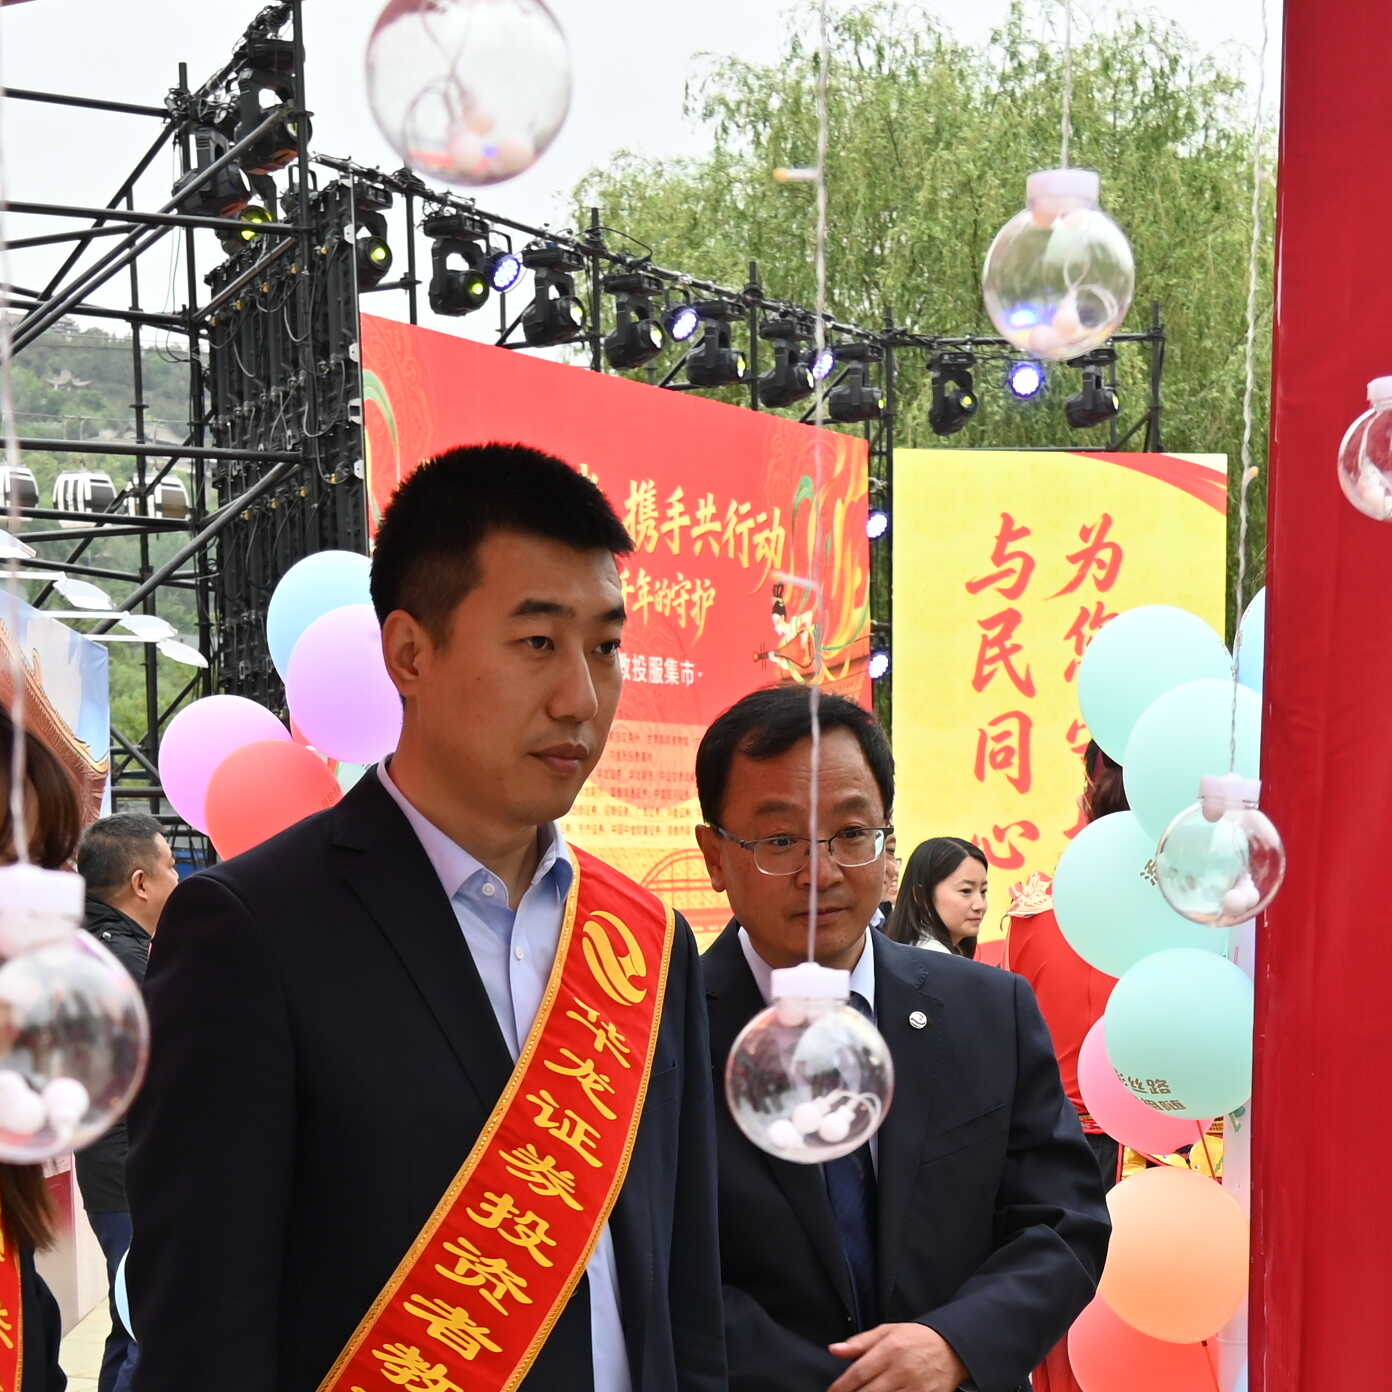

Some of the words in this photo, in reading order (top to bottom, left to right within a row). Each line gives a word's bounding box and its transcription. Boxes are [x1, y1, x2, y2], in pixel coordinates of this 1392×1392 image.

[623, 478, 787, 592] 携手共行动
[965, 511, 1039, 870] 与民同心
